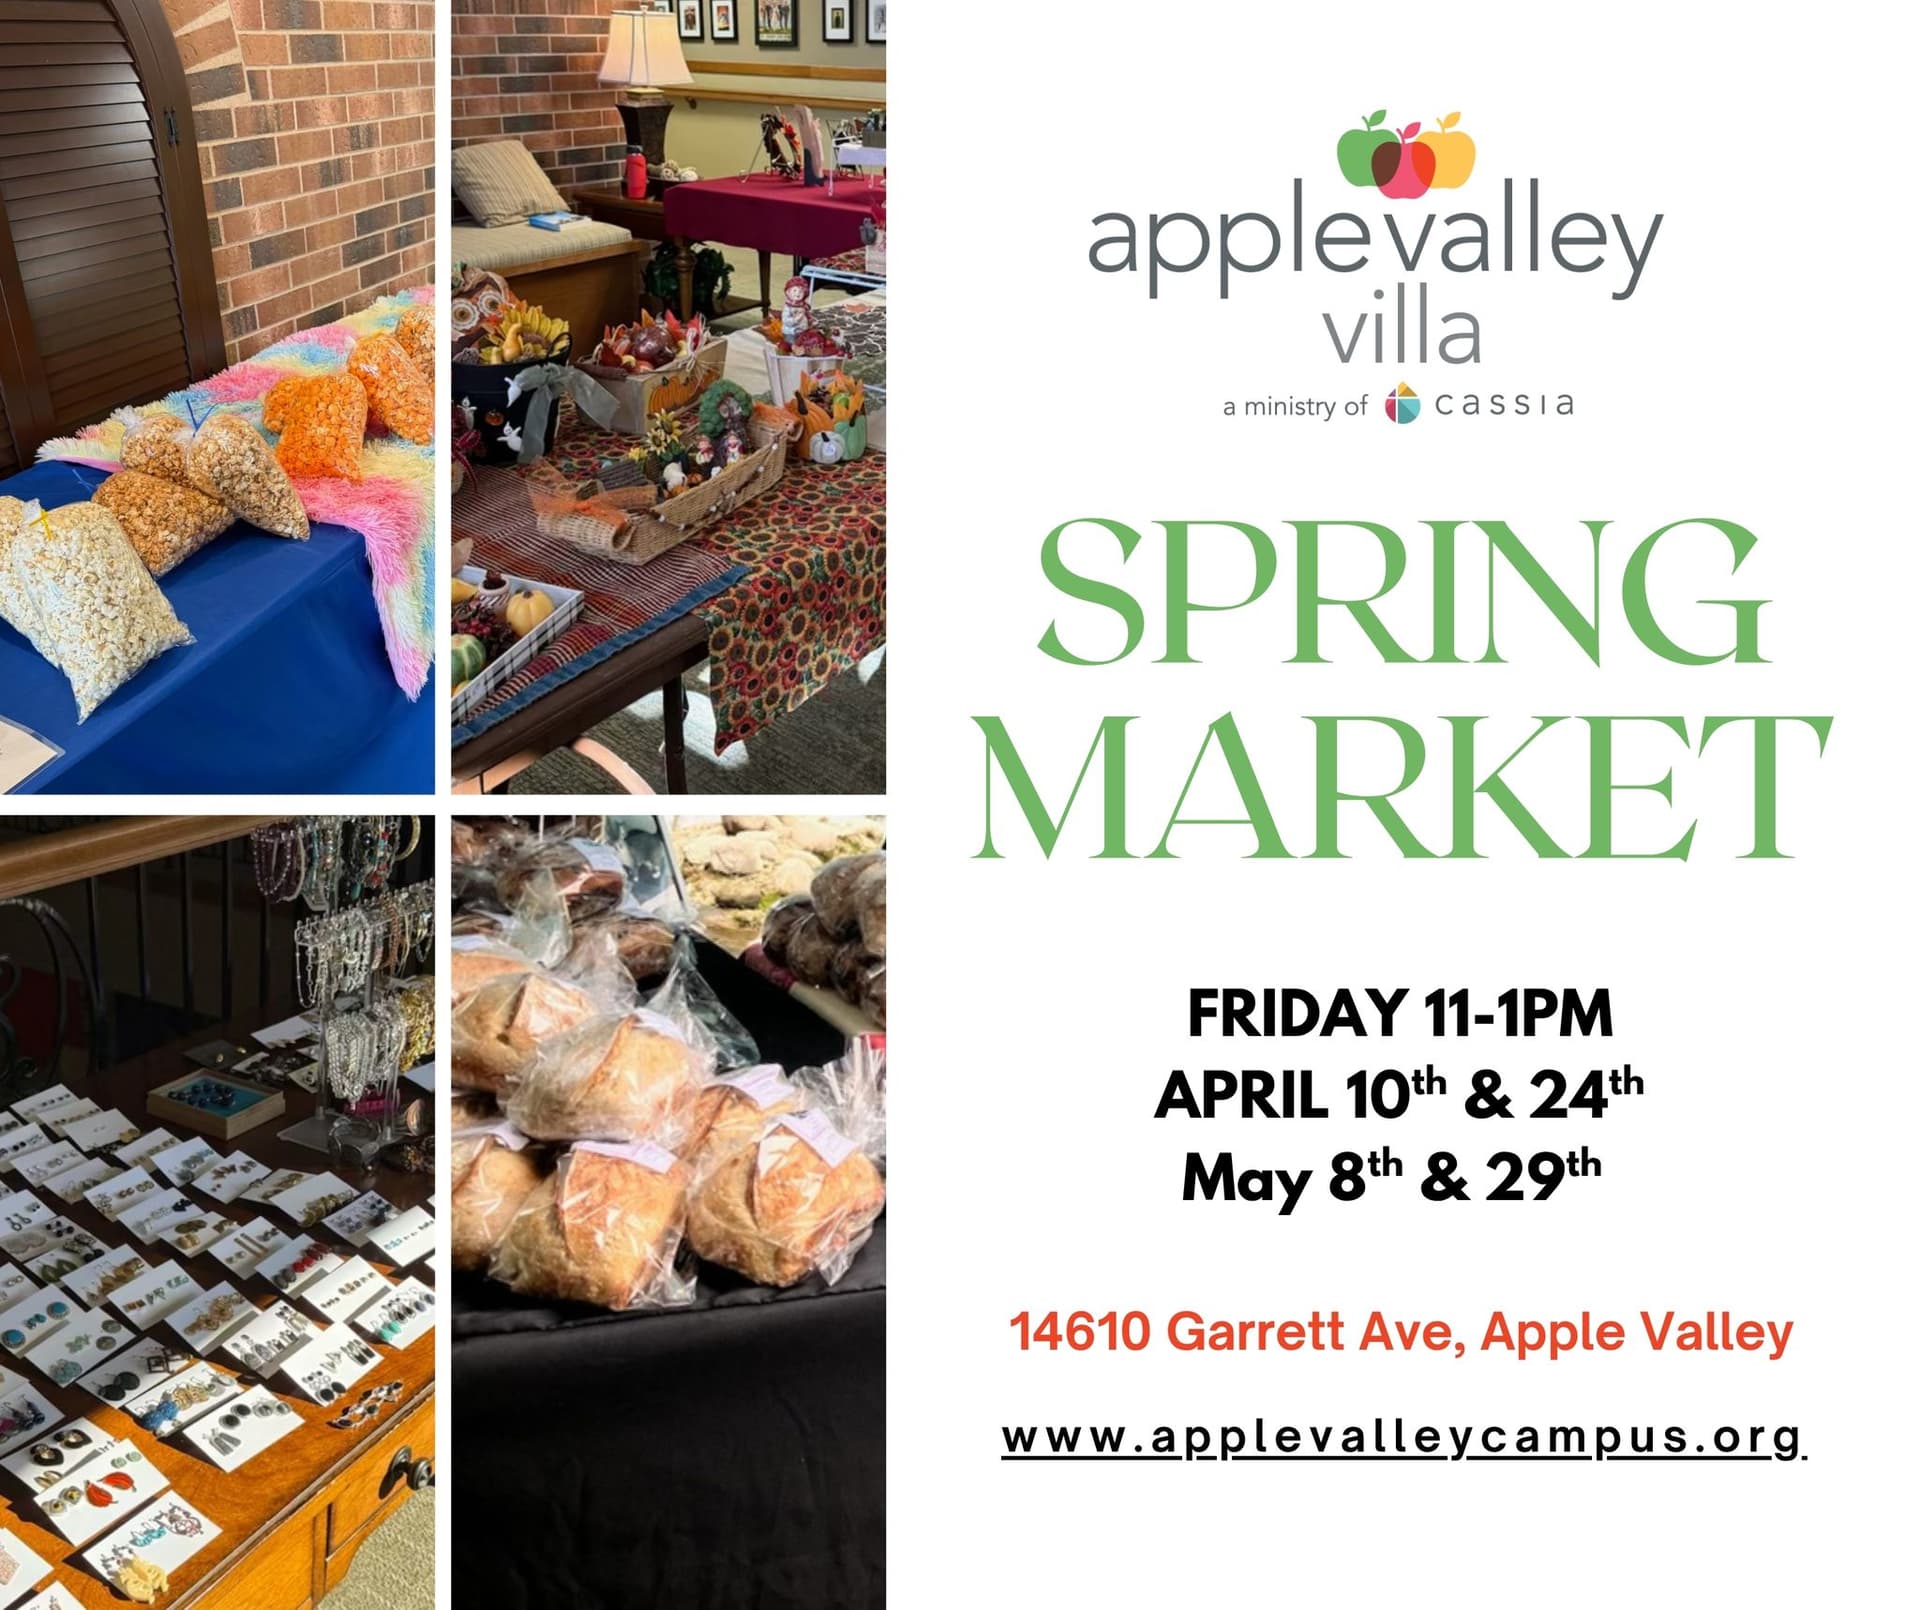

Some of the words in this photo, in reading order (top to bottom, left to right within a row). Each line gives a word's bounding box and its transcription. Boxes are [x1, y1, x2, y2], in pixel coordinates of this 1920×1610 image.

[1322, 282, 1480, 364] villa
[1224, 402, 1235, 415] a
[1246, 394, 1336, 421] ministry
[1345, 394, 1368, 415] of
[1037, 518, 1772, 667] SPRING
[971, 712, 1834, 862] MARKET
[1190, 988, 1410, 1037] FRIDAY
[1425, 988, 1613, 1036] 11-1PM
[1154, 1070, 1329, 1118] APRIL
[1465, 1069, 1515, 1119] &
[1183, 1152, 1313, 1215] May
[1421, 1151, 1471, 1201] &
[1010, 1311, 1150, 1351] 14610
[1168, 1311, 1344, 1351] Garrett
[1359, 1311, 1465, 1358] Ave,
[1481, 1311, 1625, 1360] Apple
[1640, 1311, 1794, 1360] Valley
[1001, 1418, 1808, 1461] www.applevalleycampus.org
